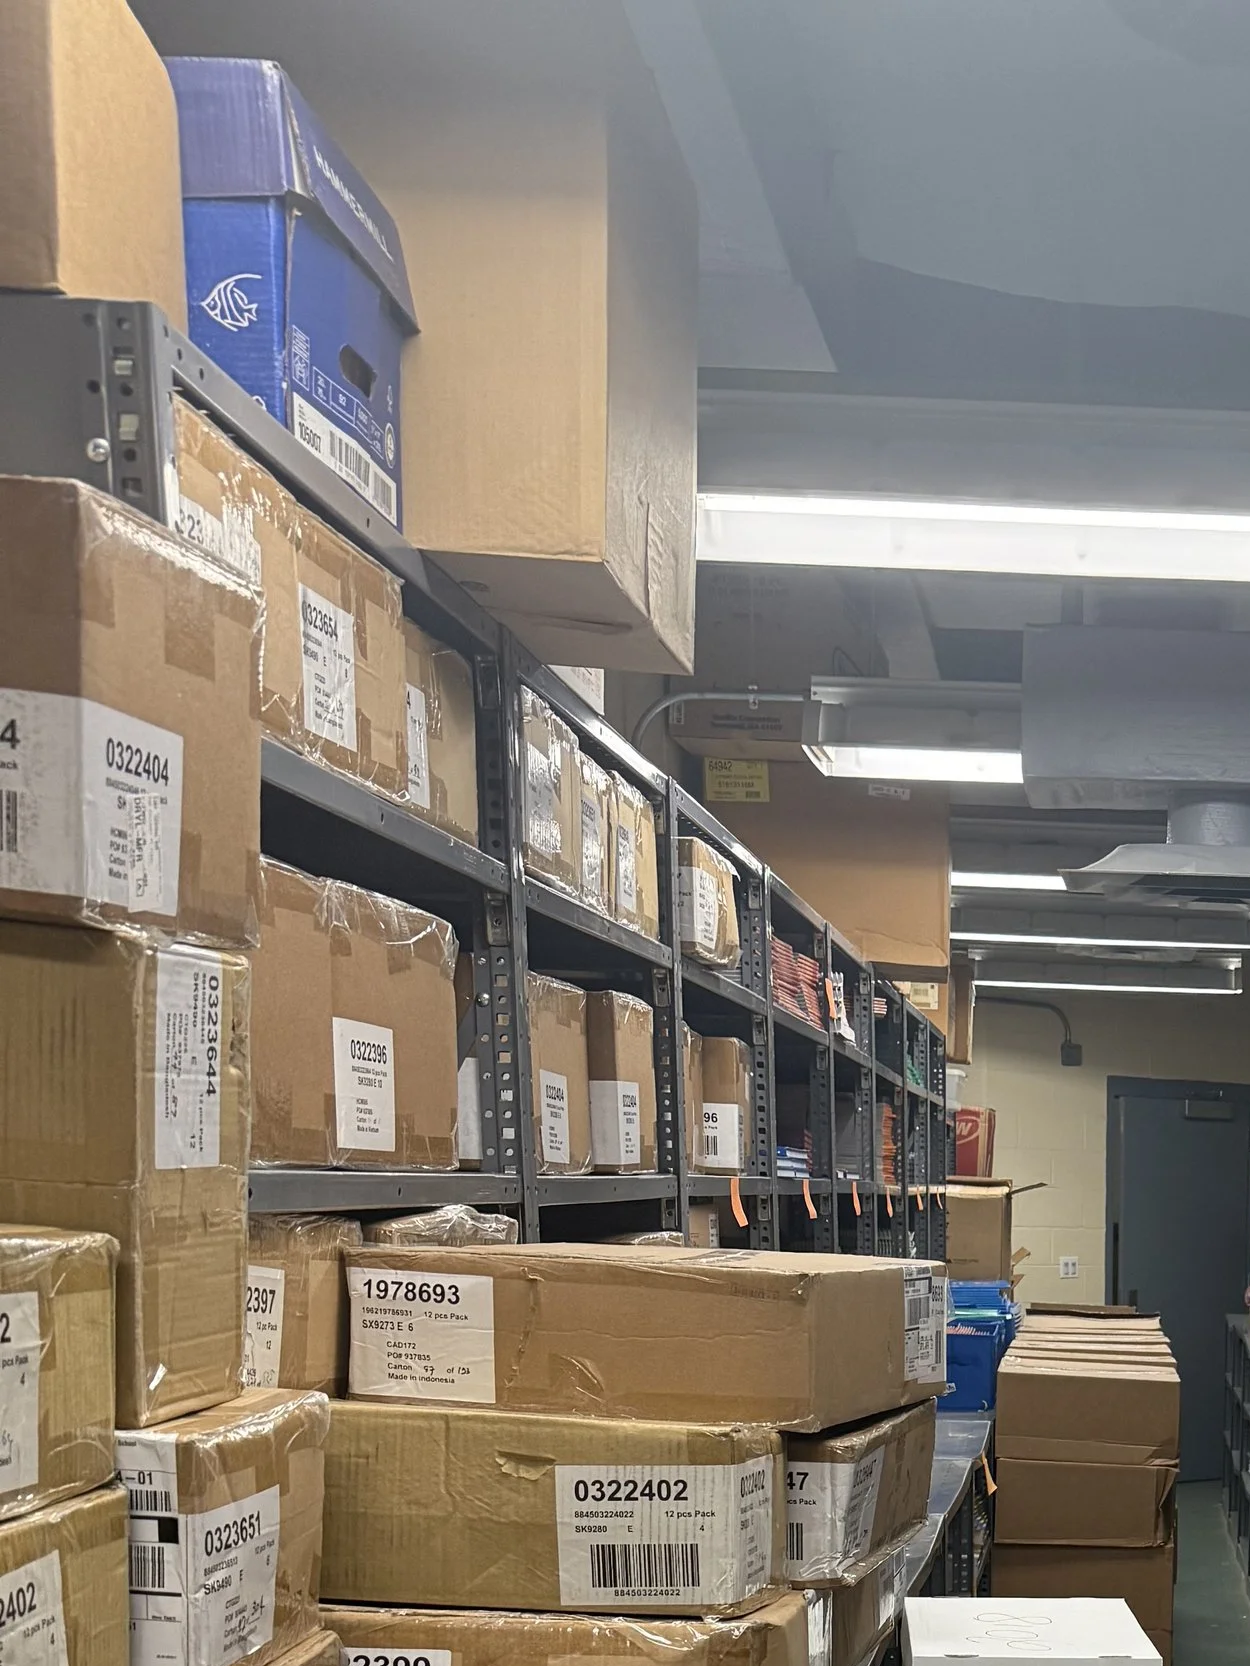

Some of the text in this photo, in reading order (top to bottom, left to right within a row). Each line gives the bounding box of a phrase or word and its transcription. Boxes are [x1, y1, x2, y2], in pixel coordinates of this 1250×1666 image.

[314, 145, 394, 263] HAMMERMILL
[106, 737, 169, 787] 0322404
[708, 760, 733, 772] 64942
[206, 974, 219, 1098] 0323644
[350, 1039, 387, 1065] 0322396
[704, 1113, 718, 1123] 96
[363, 1279, 461, 1305] 1978693
[450, 1312, 469, 1321] Pack
[362, 1319, 414, 1332] SX9273 E 6
[386, 1341, 416, 1350] CAD172
[387, 1363, 412, 1372] Carton
[388, 1372, 408, 1381] Made
[419, 1375, 455, 1384] Indonesia
[574, 1479, 688, 1502] 0322402
[574, 1510, 716, 1519] 884503224022 12 pcs Pack
[204, 1510, 262, 1557] 0323651
[575, 1524, 705, 1533] SK9280 E 4
[614, 1588, 681, 1597] 884503224022
[42, 1615, 55, 1630] Pack
